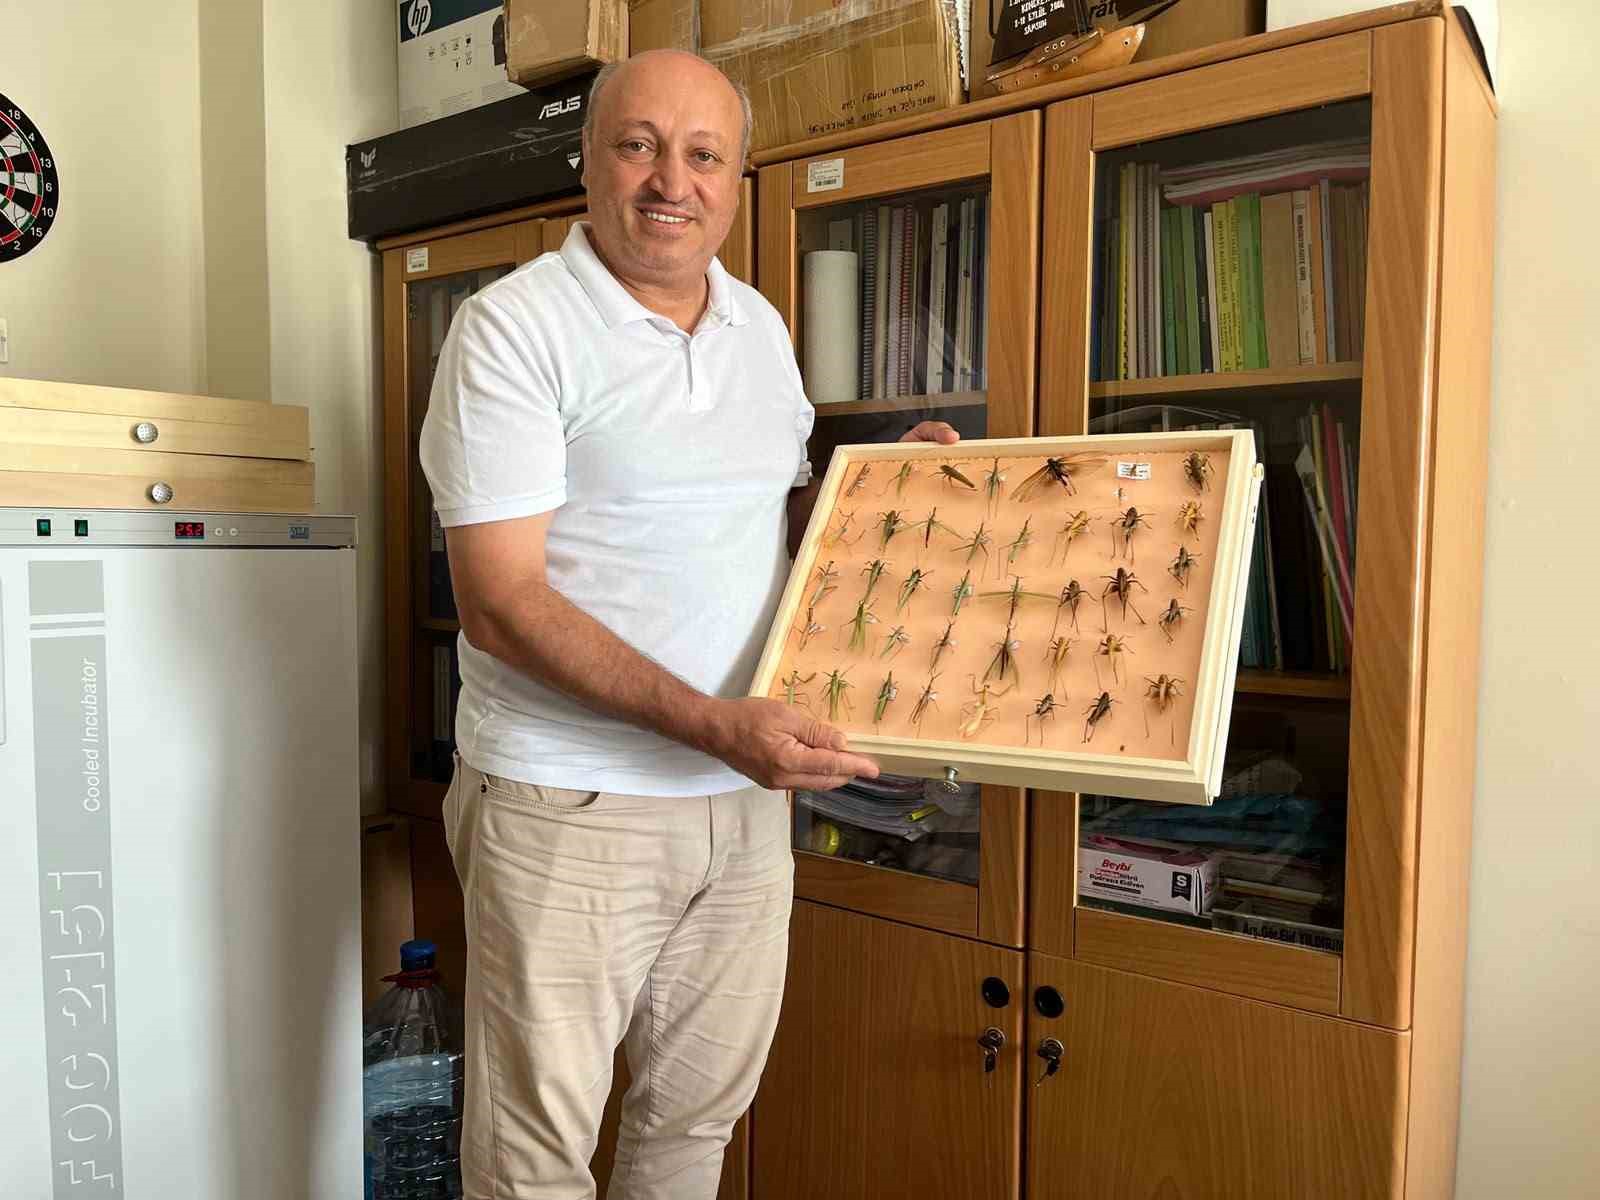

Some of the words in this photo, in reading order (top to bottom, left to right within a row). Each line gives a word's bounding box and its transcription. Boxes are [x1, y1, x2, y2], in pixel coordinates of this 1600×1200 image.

[411, 0, 429, 37] hp
[538, 95, 581, 119] ASUS
[8, 108, 21, 120] 18
[28, 132, 36, 143] 4
[40, 157, 52, 169] 13
[45, 181, 53, 192] 6
[42, 207, 54, 218] 10
[30, 227, 43, 238] 15
[13, 240, 21, 250] 2
[80, 658, 99, 744] Incubator
[81, 749, 101, 812] Cooled
[1102, 858, 1132, 872] Beybi
[1175, 874, 1188, 887] S
[56, 1052, 114, 1190] FOC
